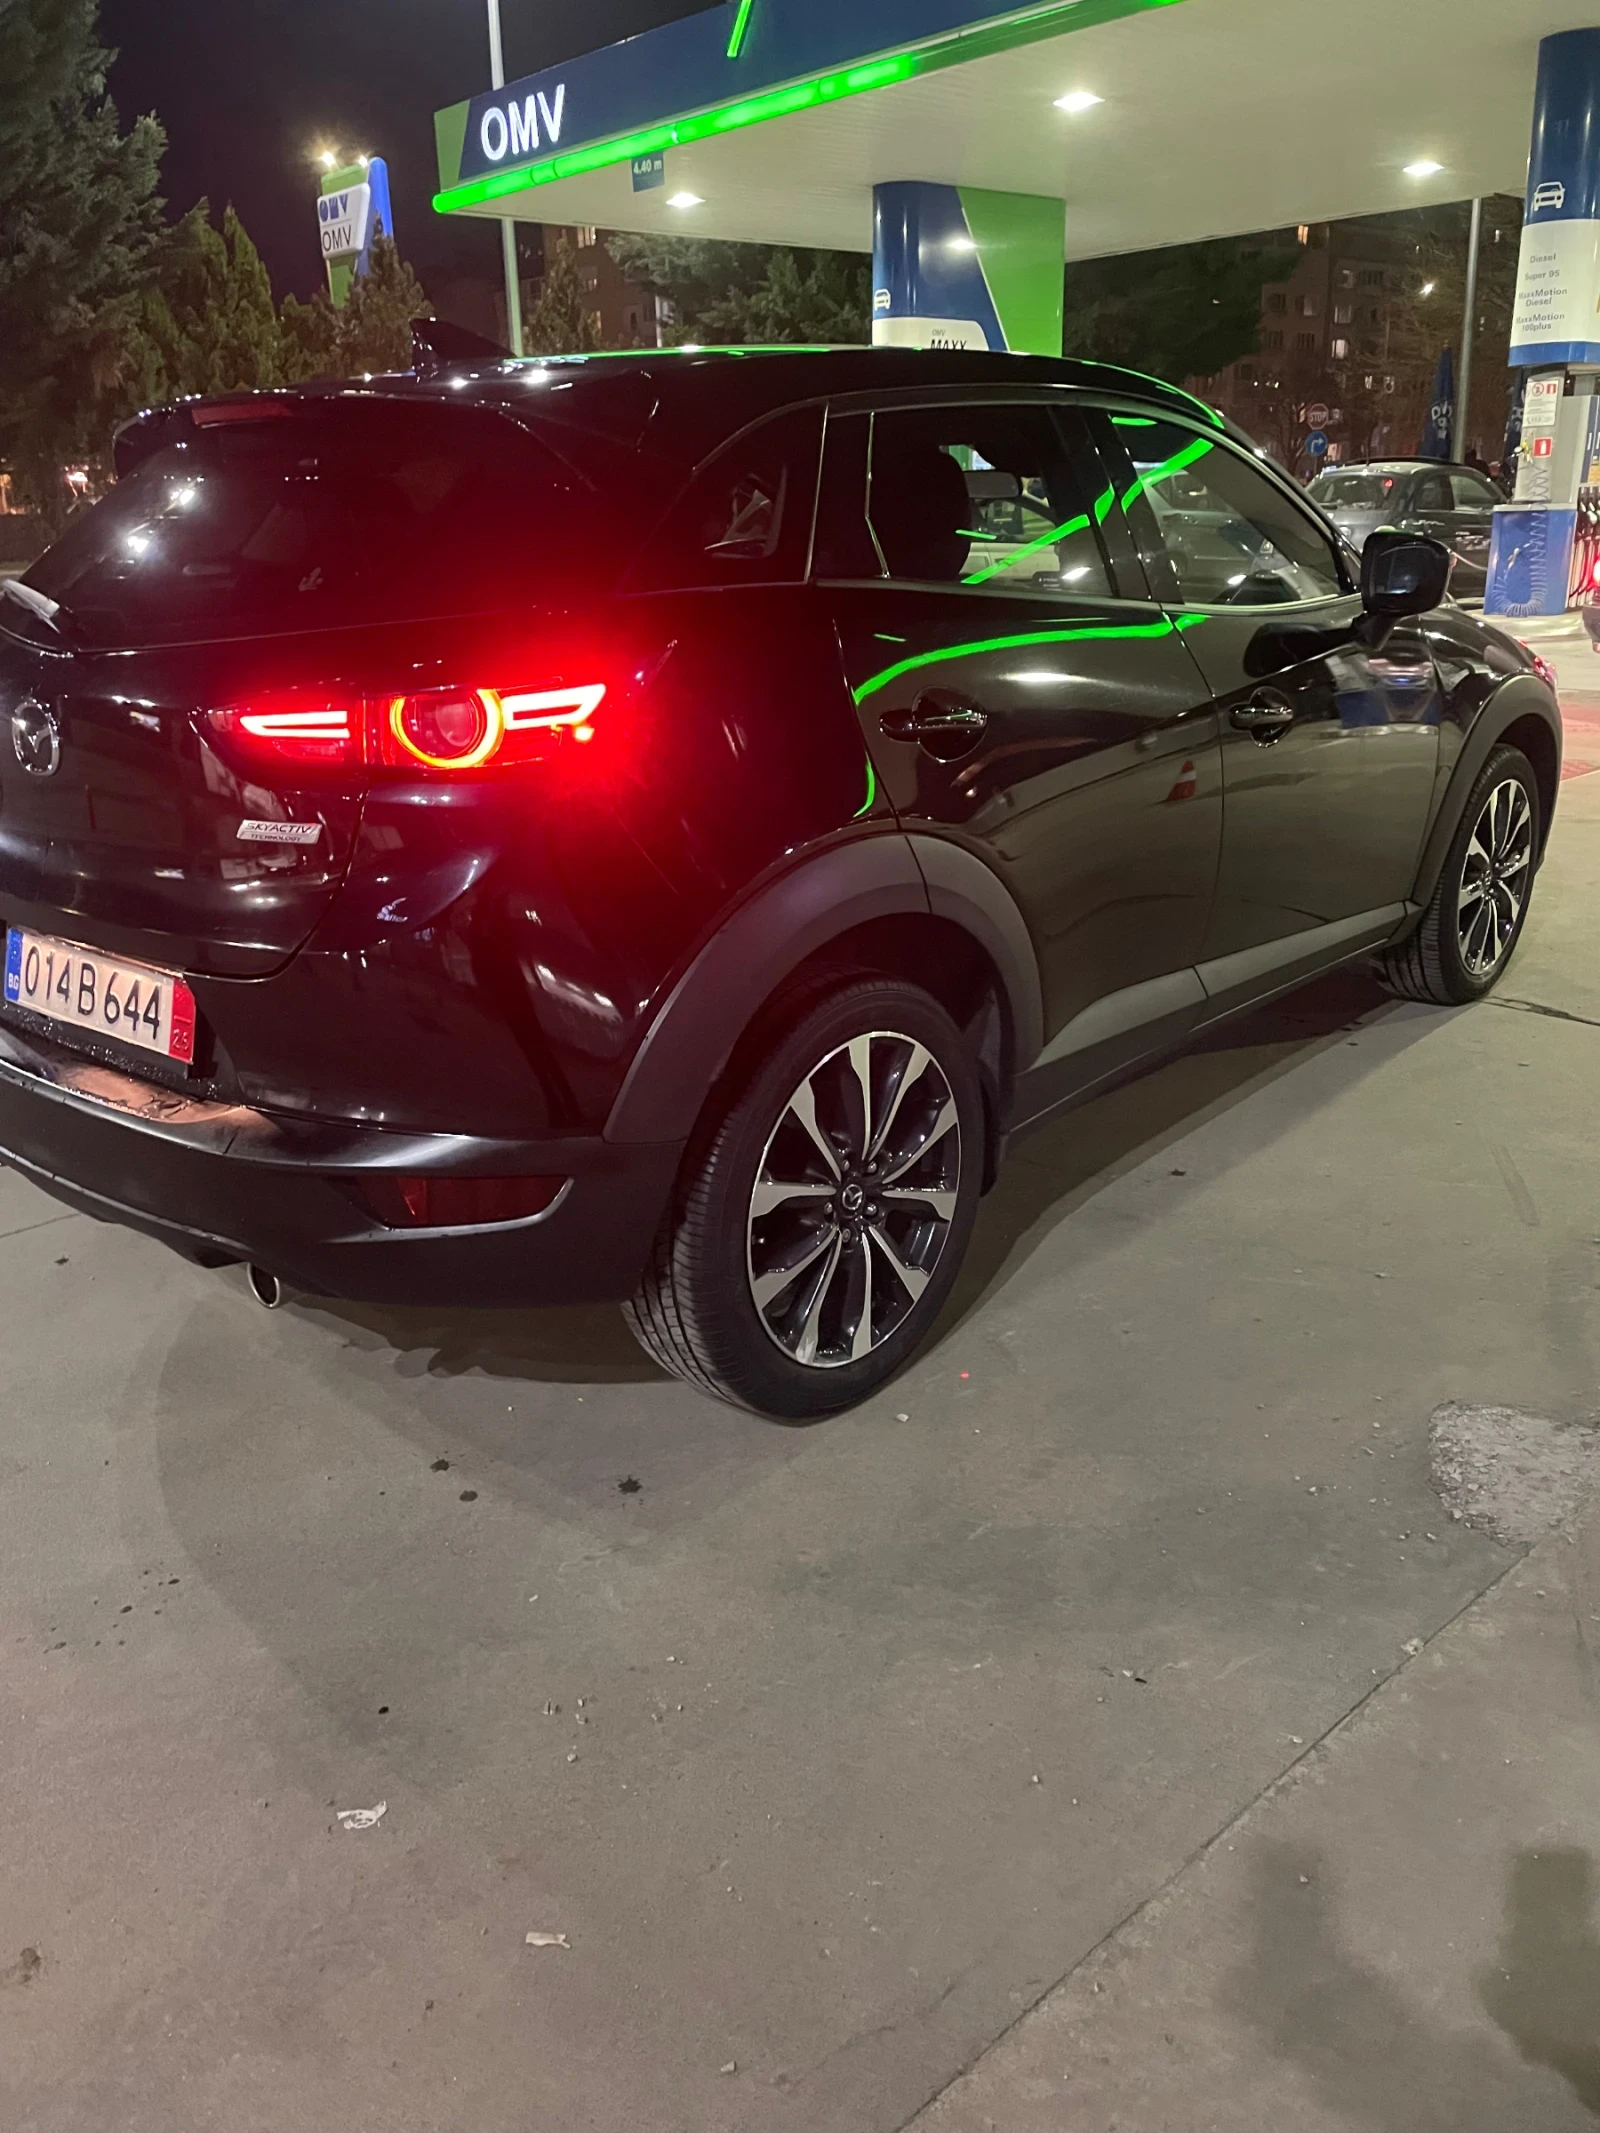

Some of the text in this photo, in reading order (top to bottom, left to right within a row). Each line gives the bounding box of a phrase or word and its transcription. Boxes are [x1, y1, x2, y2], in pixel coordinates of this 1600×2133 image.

[481, 84, 565, 160] OMV
[633, 158, 662, 174] 4.40 m
[322, 225, 352, 252] OMV
[1529, 253, 1557, 263] Diesel
[1525, 269, 1560, 281] Super 95
[1518, 287, 1567, 299] MaxxMotion
[1525, 297, 1553, 307] Diesel
[1516, 313, 1565, 324] MaxxMotion
[1309, 411, 1327, 422] STOP
[247, 822, 312, 834] SKYACTIV
[8, 972, 20, 990] BG
